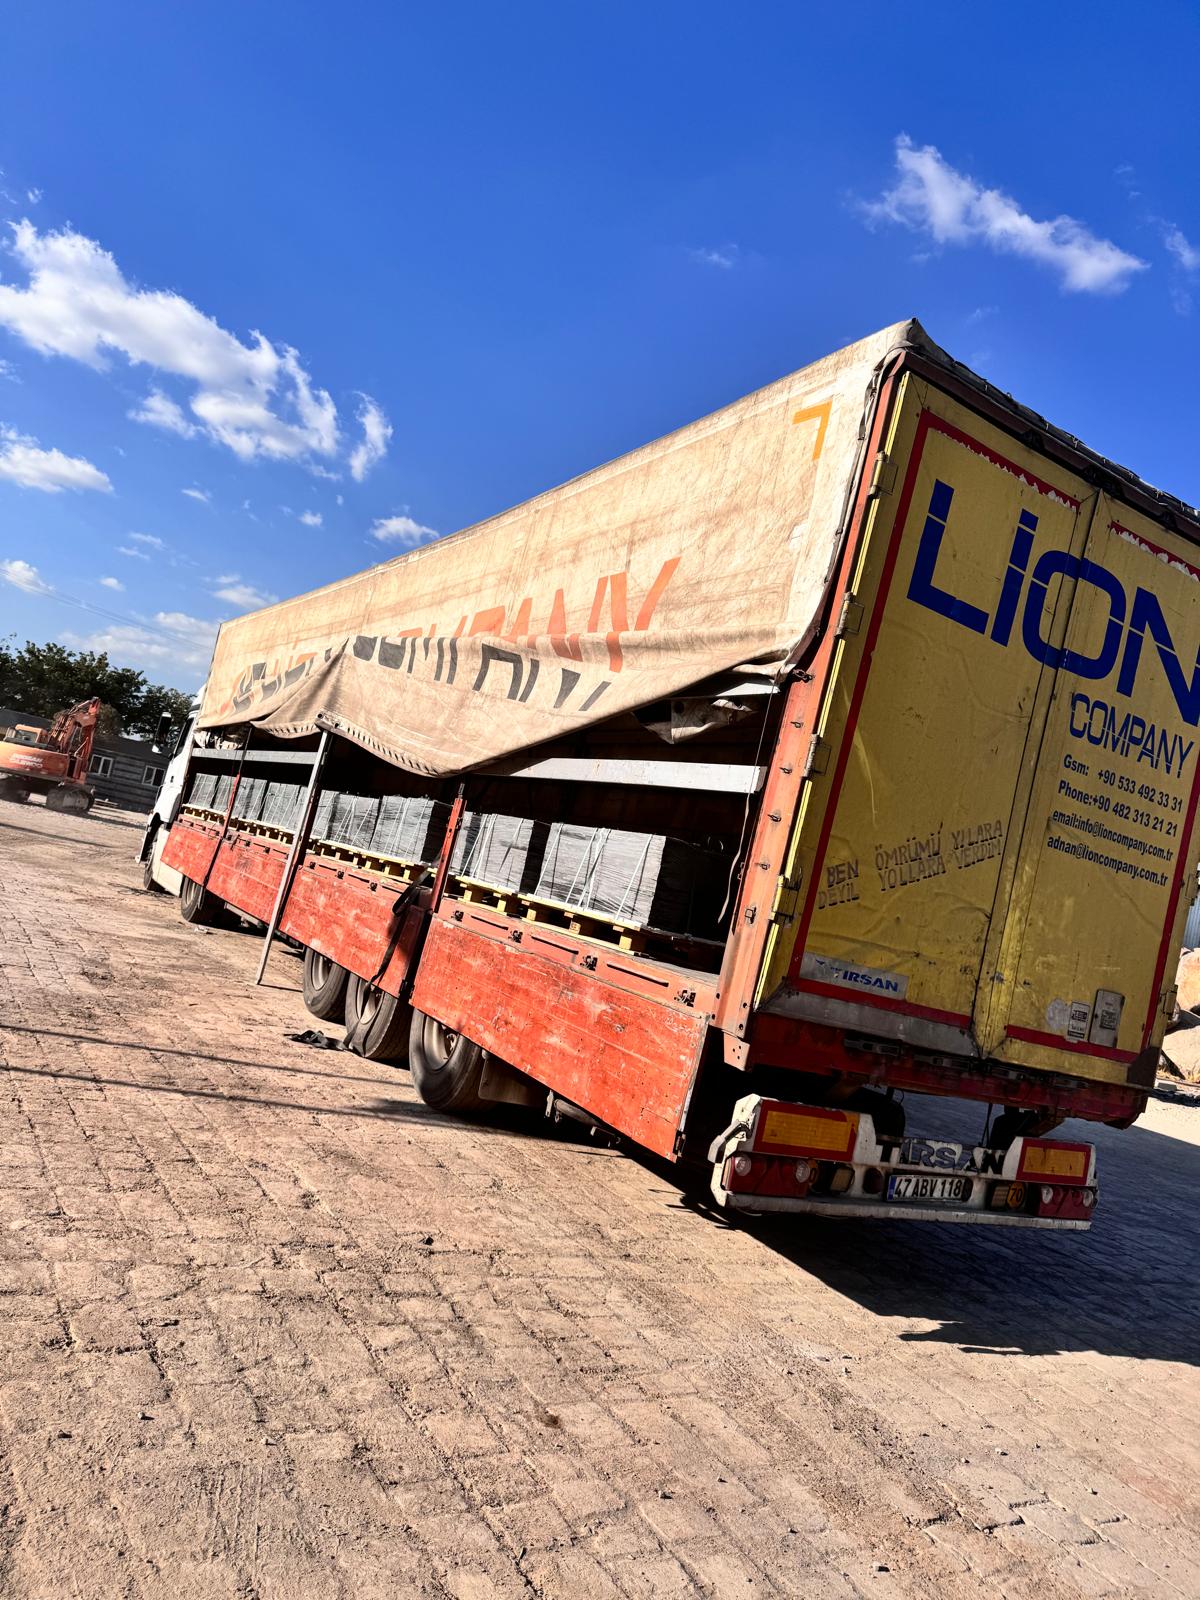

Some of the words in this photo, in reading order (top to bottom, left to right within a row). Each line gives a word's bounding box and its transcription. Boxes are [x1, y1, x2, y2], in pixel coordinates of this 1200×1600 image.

[1069, 692, 1195, 779] COMPANY
[1063, 753, 1090, 777] Gsm:
[1097, 769, 1116, 786] +90
[1117, 775, 1137, 795] 533
[1137, 783, 1157, 803] 492
[1157, 791, 1170, 808] 33
[1171, 796, 1183, 813] 31
[1112, 801, 1131, 820] 482
[1132, 808, 1151, 828] 313
[1152, 816, 1165, 833] 21
[1166, 821, 1178, 838] 21
[827, 859, 859, 888] BEN
[1047, 835, 1169, 887] adnan@lioncompany.com.tr
[894, 1178, 912, 1198] 47
[912, 1177, 939, 1198] ABV
[940, 1177, 963, 1198] 118
[1010, 1187, 1023, 1200] 70
